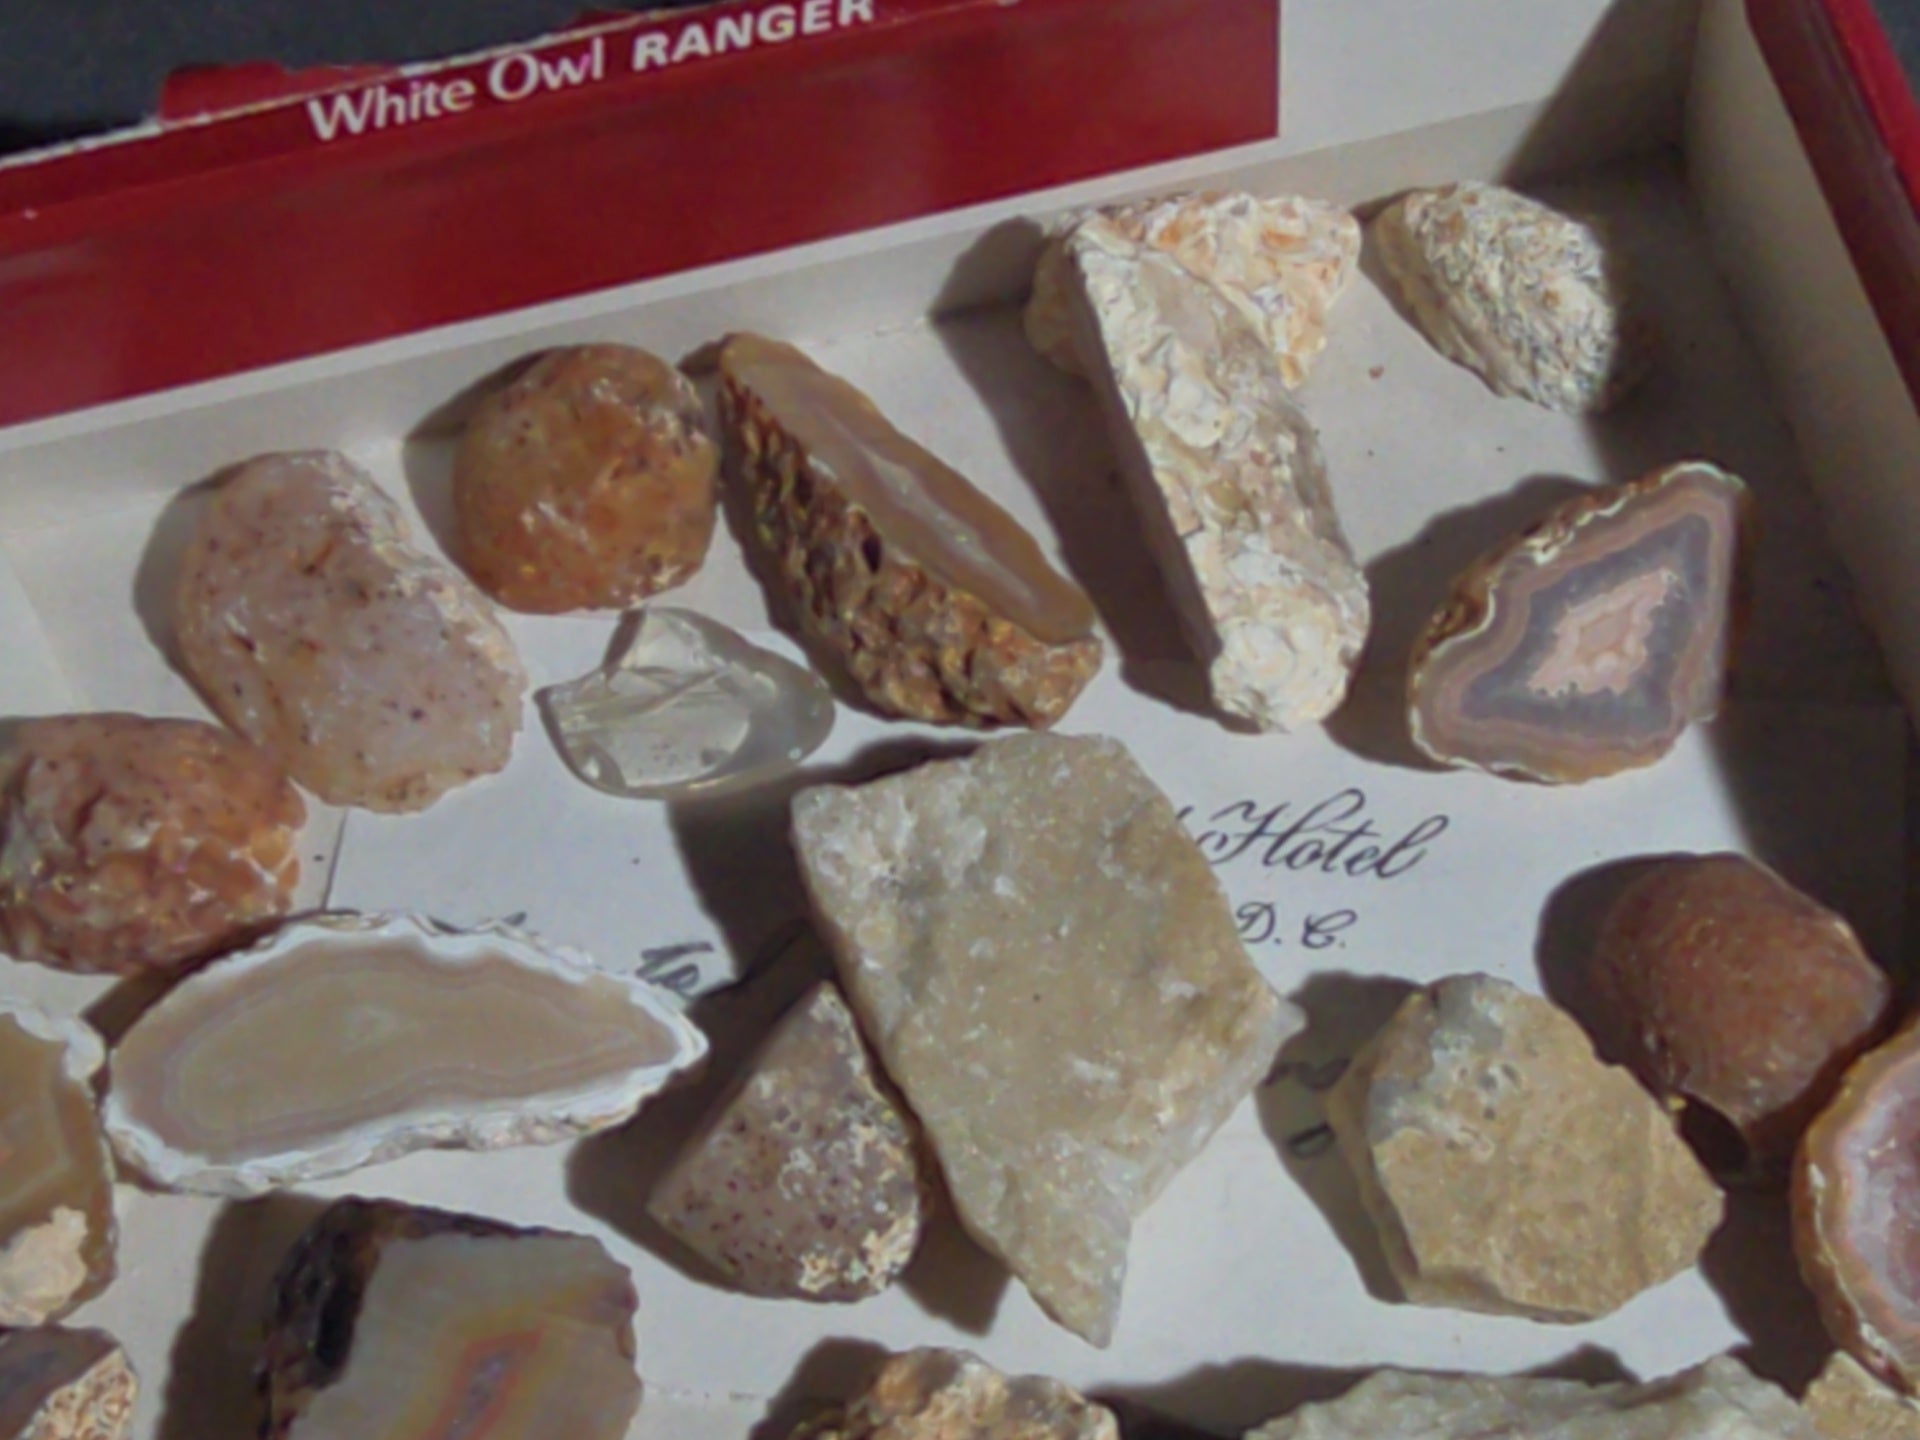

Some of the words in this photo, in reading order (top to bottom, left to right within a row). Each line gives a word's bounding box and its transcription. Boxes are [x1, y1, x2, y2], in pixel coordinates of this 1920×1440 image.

[306, 79, 476, 141] White
[488, 37, 605, 100] Owl
[632, 0, 875, 71] RANGER
[1209, 788, 1450, 879] Hotel
